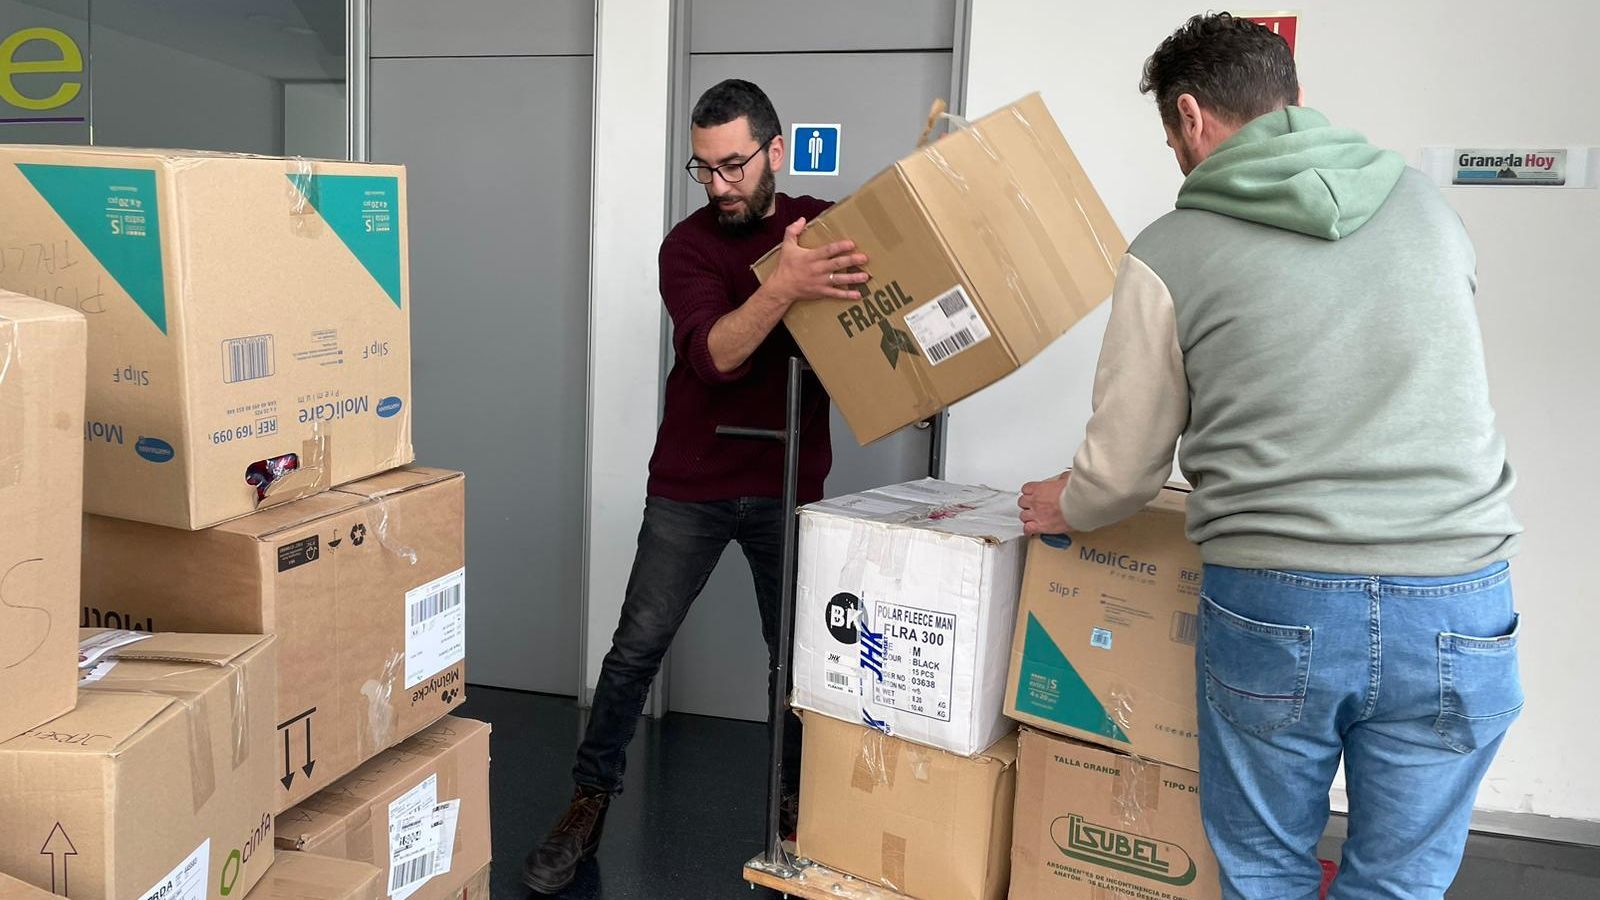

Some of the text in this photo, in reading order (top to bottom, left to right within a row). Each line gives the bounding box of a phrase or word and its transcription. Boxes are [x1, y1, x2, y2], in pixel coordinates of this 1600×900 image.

[1459, 154, 1555, 170] Granada Hoy
[111, 219, 120, 235] S
[365, 219, 371, 232] S
[837, 280, 914, 338] FRAGIL
[363, 341, 388, 359] Slip F
[112, 365, 149, 386] Slip F
[298, 395, 368, 424] MoliCare
[213, 419, 276, 444] REF 169 099
[1079, 546, 1157, 577] MoliCare
[1181, 570, 1200, 581] REF
[1048, 581, 1080, 597] Slip F
[830, 604, 863, 632] BK
[877, 605, 953, 631] POLAR FLEECE MAN
[884, 624, 945, 646] FLRA 300
[860, 621, 883, 682] JHK
[912, 646, 921, 657] M
[912, 658, 940, 670] BLACK
[911, 677, 936, 688] 03638
[912, 669, 935, 679] 15 PCS
[412, 668, 459, 702] Mölnlycke
[1050, 679, 1057, 689] S
[937, 710, 946, 718] KG
[1054, 754, 1121, 777] TALLA GRANDE
[1163, 780, 1185, 791] TIPO
[1098, 881, 1135, 897] ELÁSTICOS
[1106, 877, 1160, 897] INCONTINENCIA
